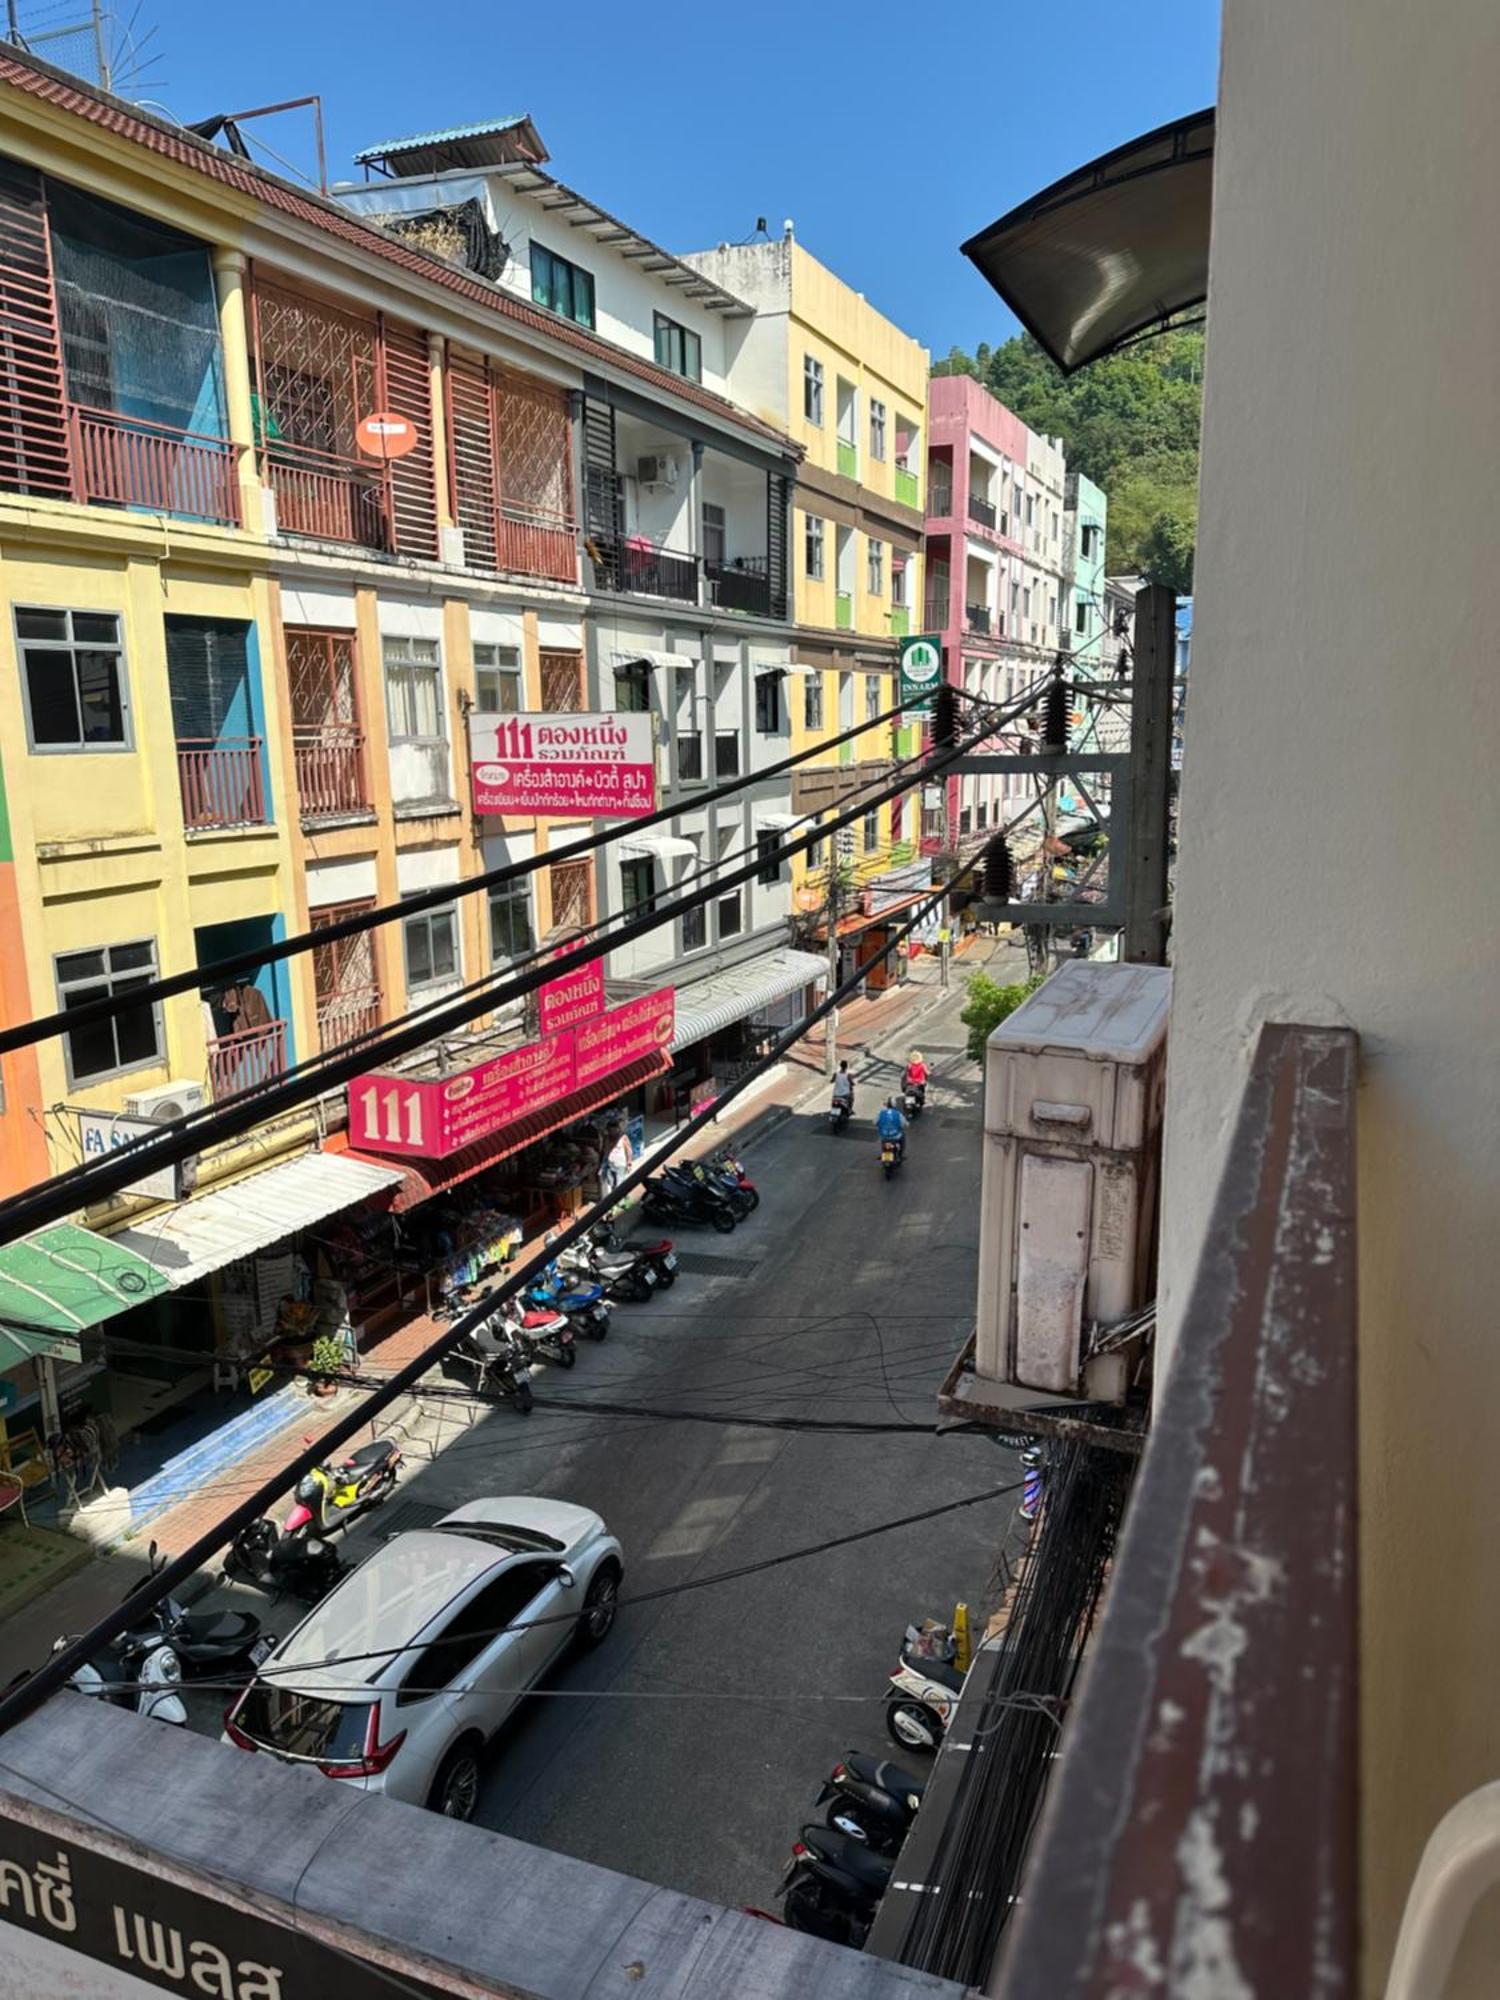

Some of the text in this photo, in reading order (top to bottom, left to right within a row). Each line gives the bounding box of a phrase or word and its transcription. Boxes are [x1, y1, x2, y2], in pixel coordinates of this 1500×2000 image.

[494, 716, 533, 759] 111
[538, 715, 628, 745] ตองหนึ่ง
[623, 770, 647, 790] สปา
[544, 969, 600, 1011] ตองหนึ่ง
[361, 1086, 424, 1146] 111
[113, 1904, 283, 2000] เพลส
